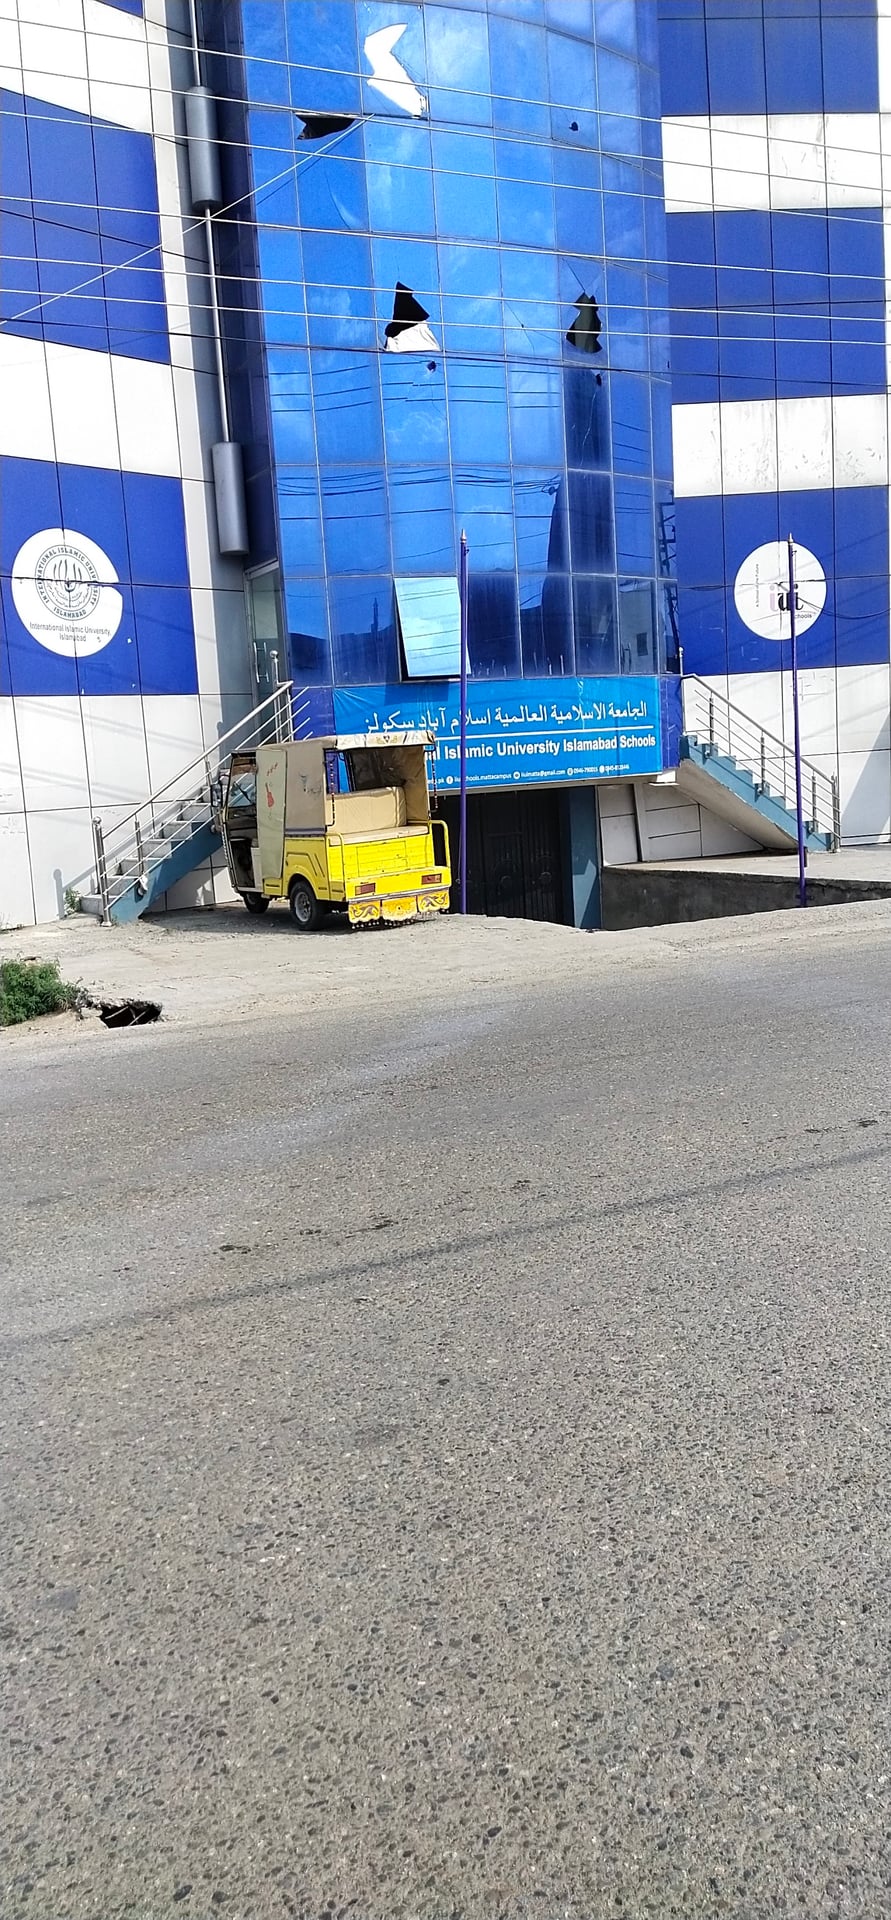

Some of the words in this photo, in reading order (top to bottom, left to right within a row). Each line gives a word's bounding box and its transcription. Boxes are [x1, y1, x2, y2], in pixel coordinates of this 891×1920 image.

[57, 547, 86, 561] ISLAMIC
[84, 561, 98, 606] UNIVSITY
[53, 606, 87, 618] ISLAMABAD
[30, 621, 64, 632] International
[64, 624, 84, 633] Islamic
[59, 633, 87, 642] Islamabad
[494, 703, 548, 727] العالمية
[550, 702, 606, 725] الاسلامية
[608, 700, 647, 721] الجامعة
[496, 739, 560, 756] University
[563, 736, 617, 752] Islamabad
[619, 733, 656, 748] Schools
